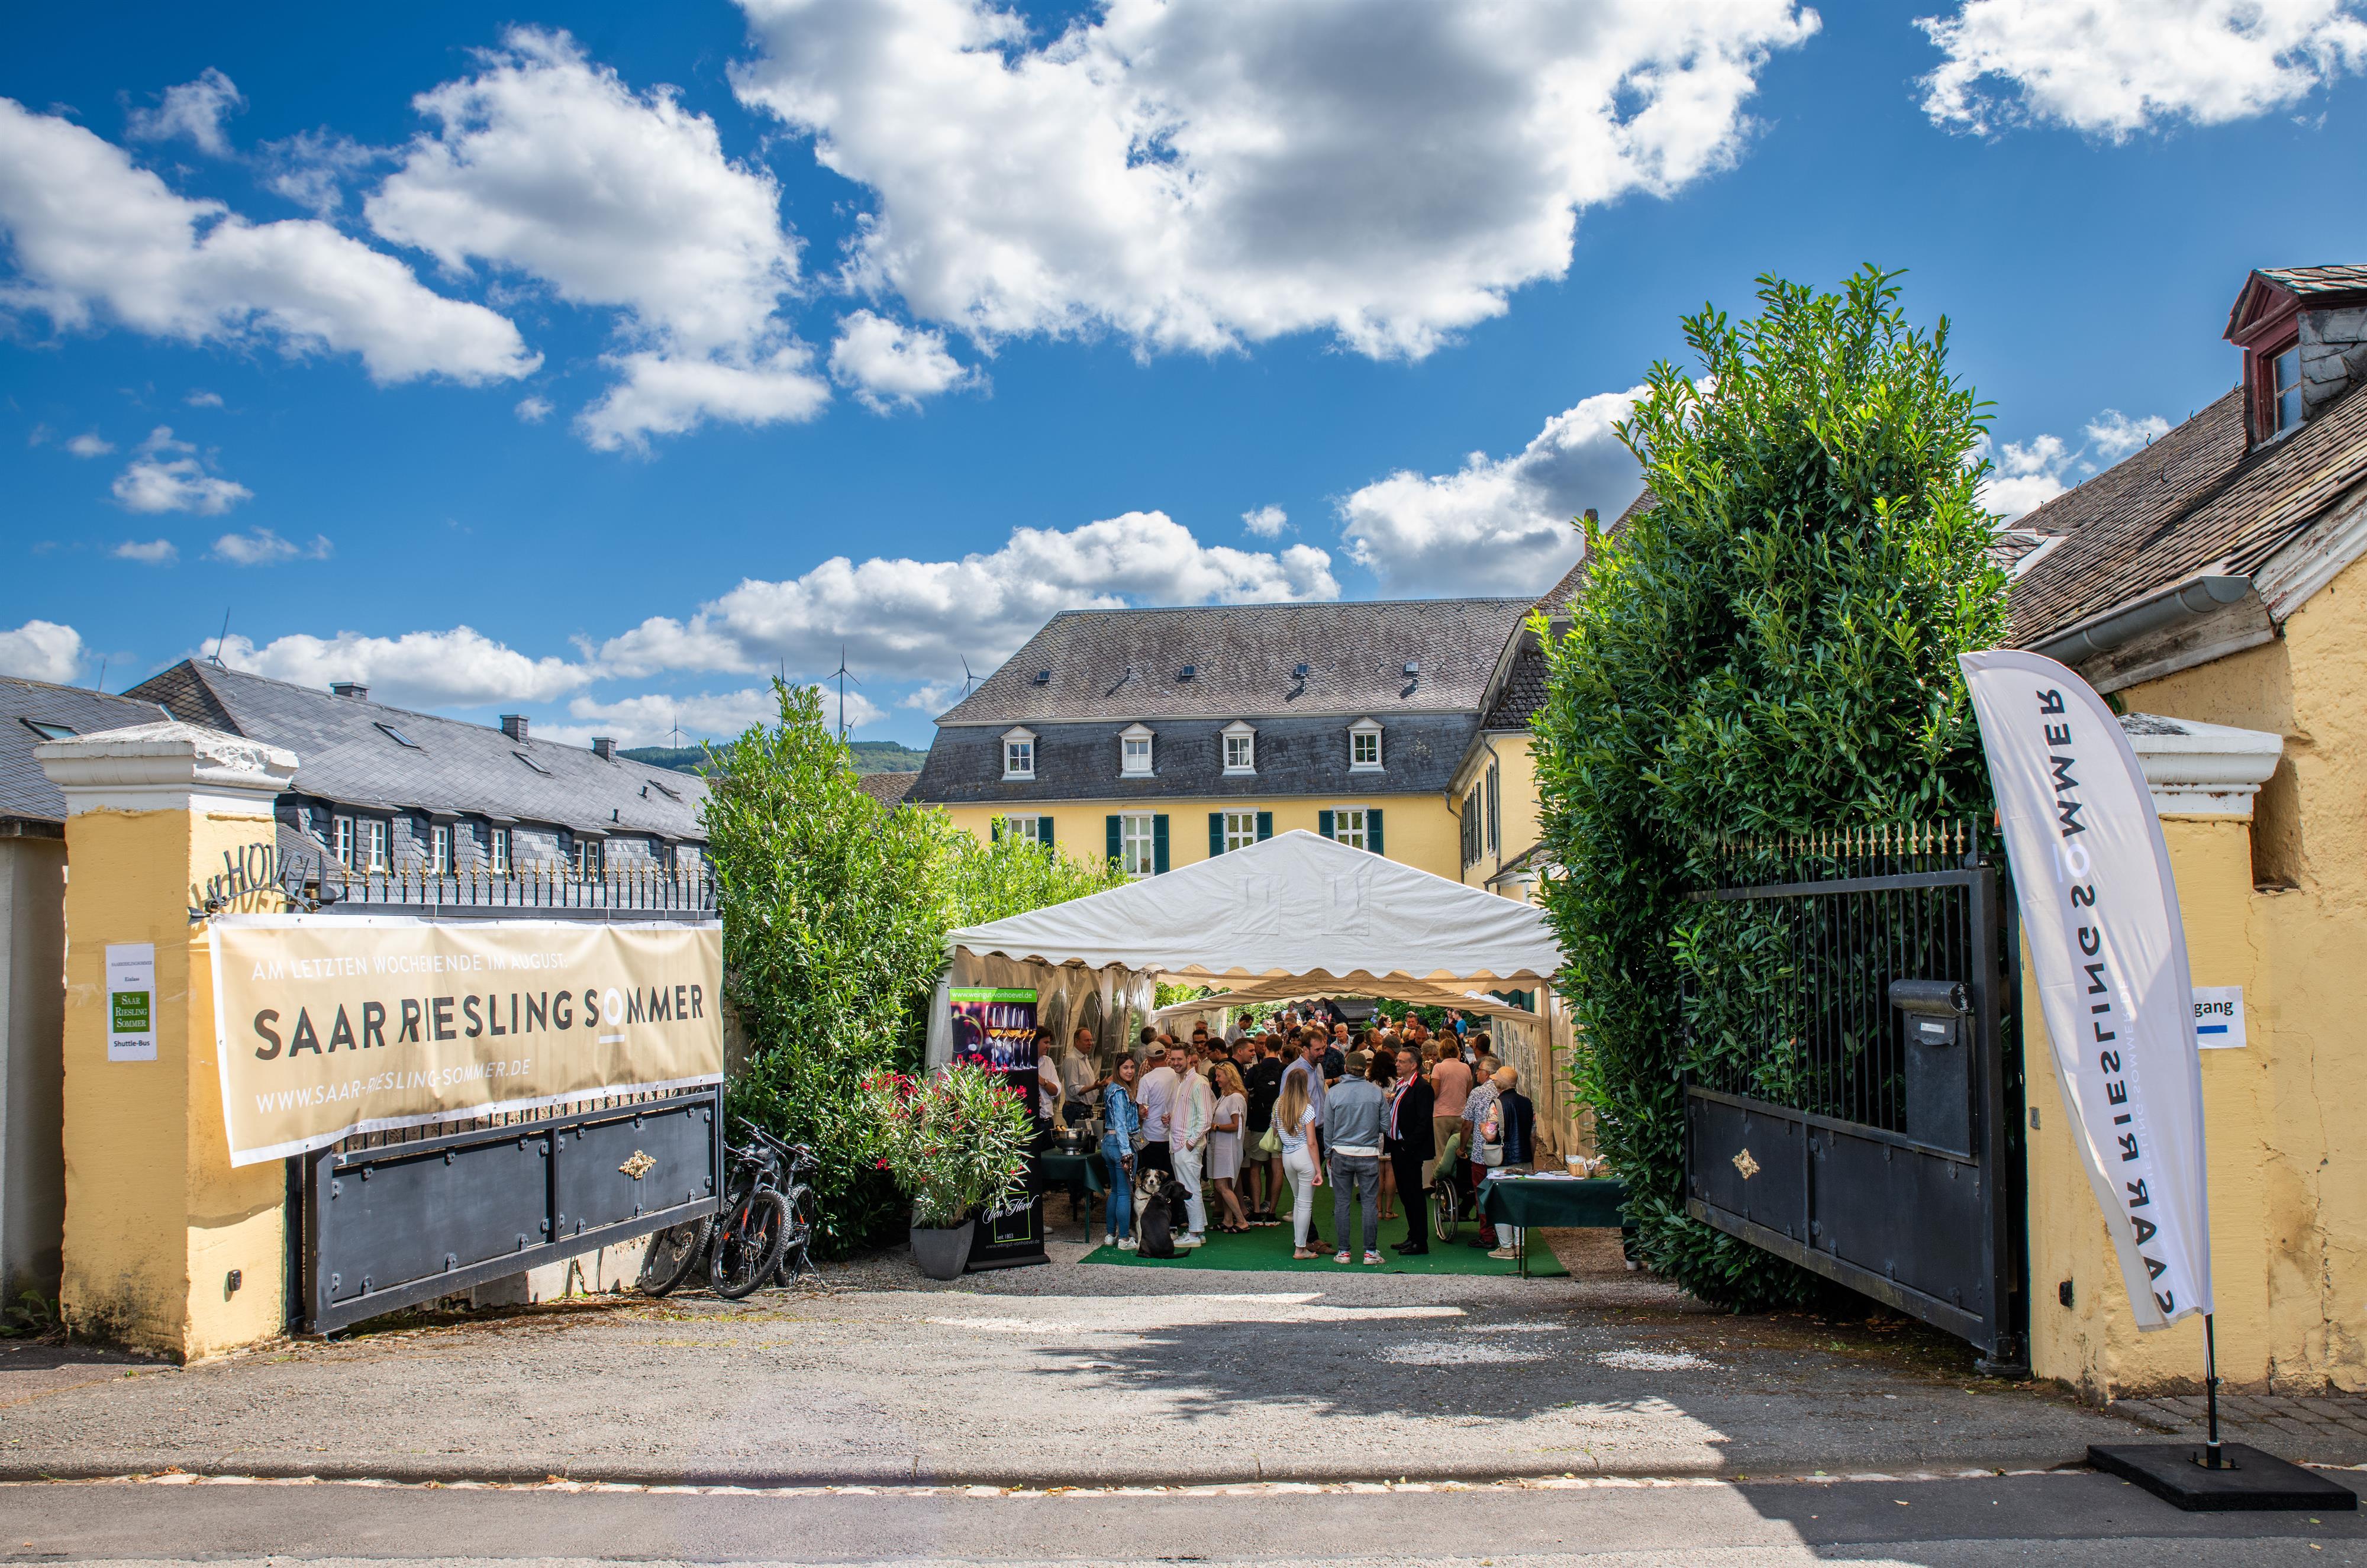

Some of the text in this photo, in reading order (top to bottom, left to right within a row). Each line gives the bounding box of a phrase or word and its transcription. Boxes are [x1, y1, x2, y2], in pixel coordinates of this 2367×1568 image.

[251, 953, 568, 980] AM LETZTEN WOCHENENDE IM AUGUST:
[254, 984, 704, 1060] SAAR RIESLING SOMMER
[2194, 1002, 2234, 1017] gang
[256, 1059, 531, 1114] WWW.SAAR-RIESLING-SOMMER.DE
